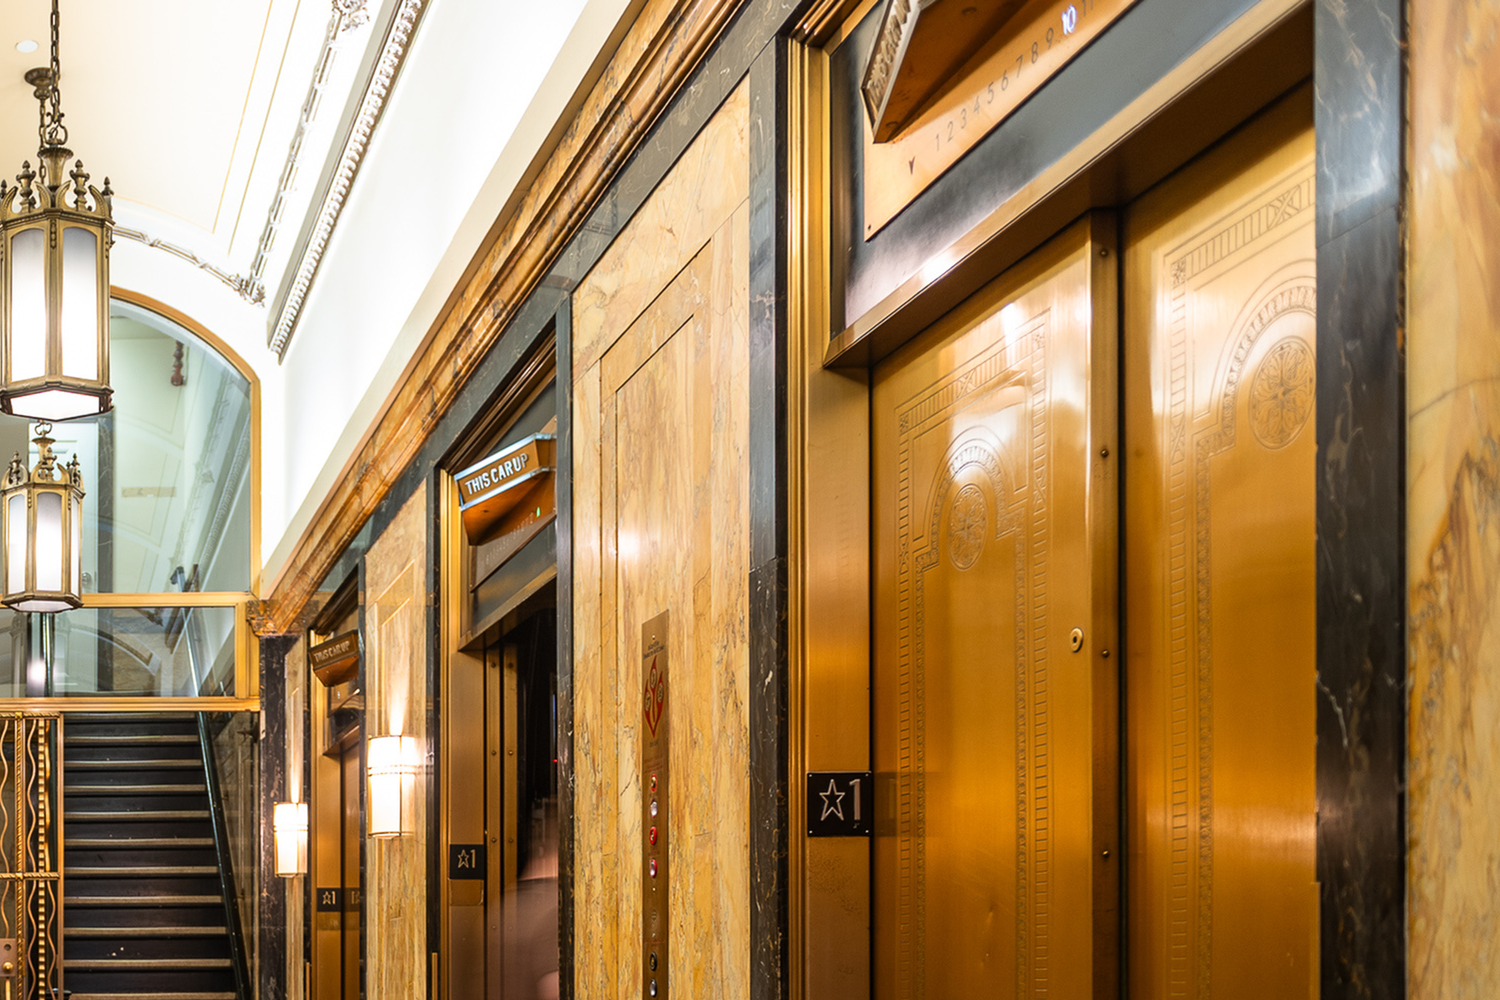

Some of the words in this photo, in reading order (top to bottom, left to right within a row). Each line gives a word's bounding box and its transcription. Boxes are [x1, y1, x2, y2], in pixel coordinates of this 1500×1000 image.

[935, 132, 940, 151] 1
[947, 120, 954, 142] 2
[960, 108, 968, 129] 3
[973, 95, 980, 115] 4
[987, 81, 995, 104] 5
[1000, 69, 1009, 91] 6
[1015, 54, 1024, 78] 7
[1031, 41, 1039, 64] 8
[1046, 27, 1054, 49] 9
[1061, 4, 1077, 36] 10
[465, 472, 491, 495] THIS
[490, 461, 514, 483] CAR
[511, 453, 528, 472] UP
[849, 778, 861, 821] 1
[470, 849, 476, 869] 1
[331, 890, 336, 905] 1
